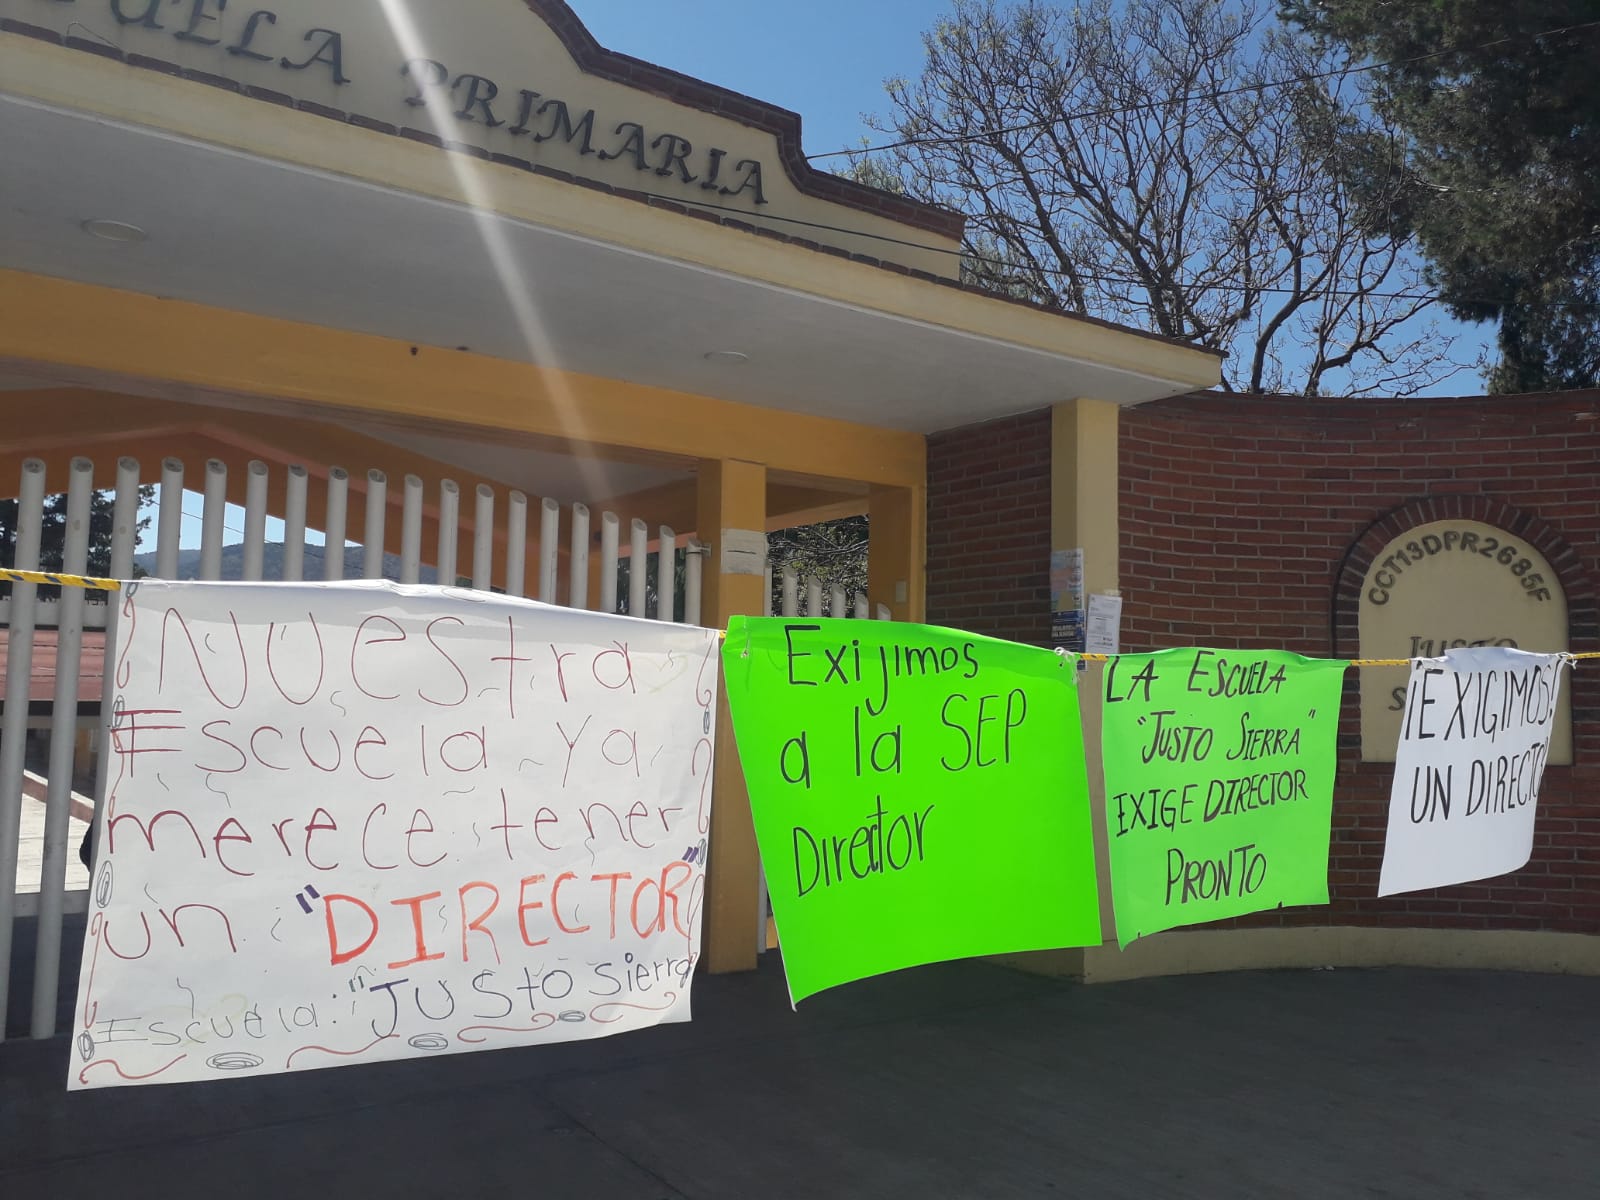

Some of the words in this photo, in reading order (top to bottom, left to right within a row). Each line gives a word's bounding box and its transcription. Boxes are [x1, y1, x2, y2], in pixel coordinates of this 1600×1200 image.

[399, 58, 768, 205] PRIMARIA
[1368, 530, 1552, 607] CCT13DPR2685F
[783, 624, 980, 717] Exijimos
[1105, 655, 1160, 703] LA
[109, 708, 488, 780] Escuela
[780, 730, 812, 790] a
[853, 705, 902, 777] la
[939, 687, 1028, 772] SEP
[107, 802, 448, 877] merece
[489, 786, 684, 862] tener
[1112, 783, 1199, 838] EXIGE
[1202, 768, 1310, 823] DIRECTOR
[1410, 764, 1453, 824] UN
[791, 794, 936, 898] Director
[1164, 843, 1267, 906] PRONTO
[103, 903, 237, 961] un
[295, 844, 700, 970] "DIRECTOR"
